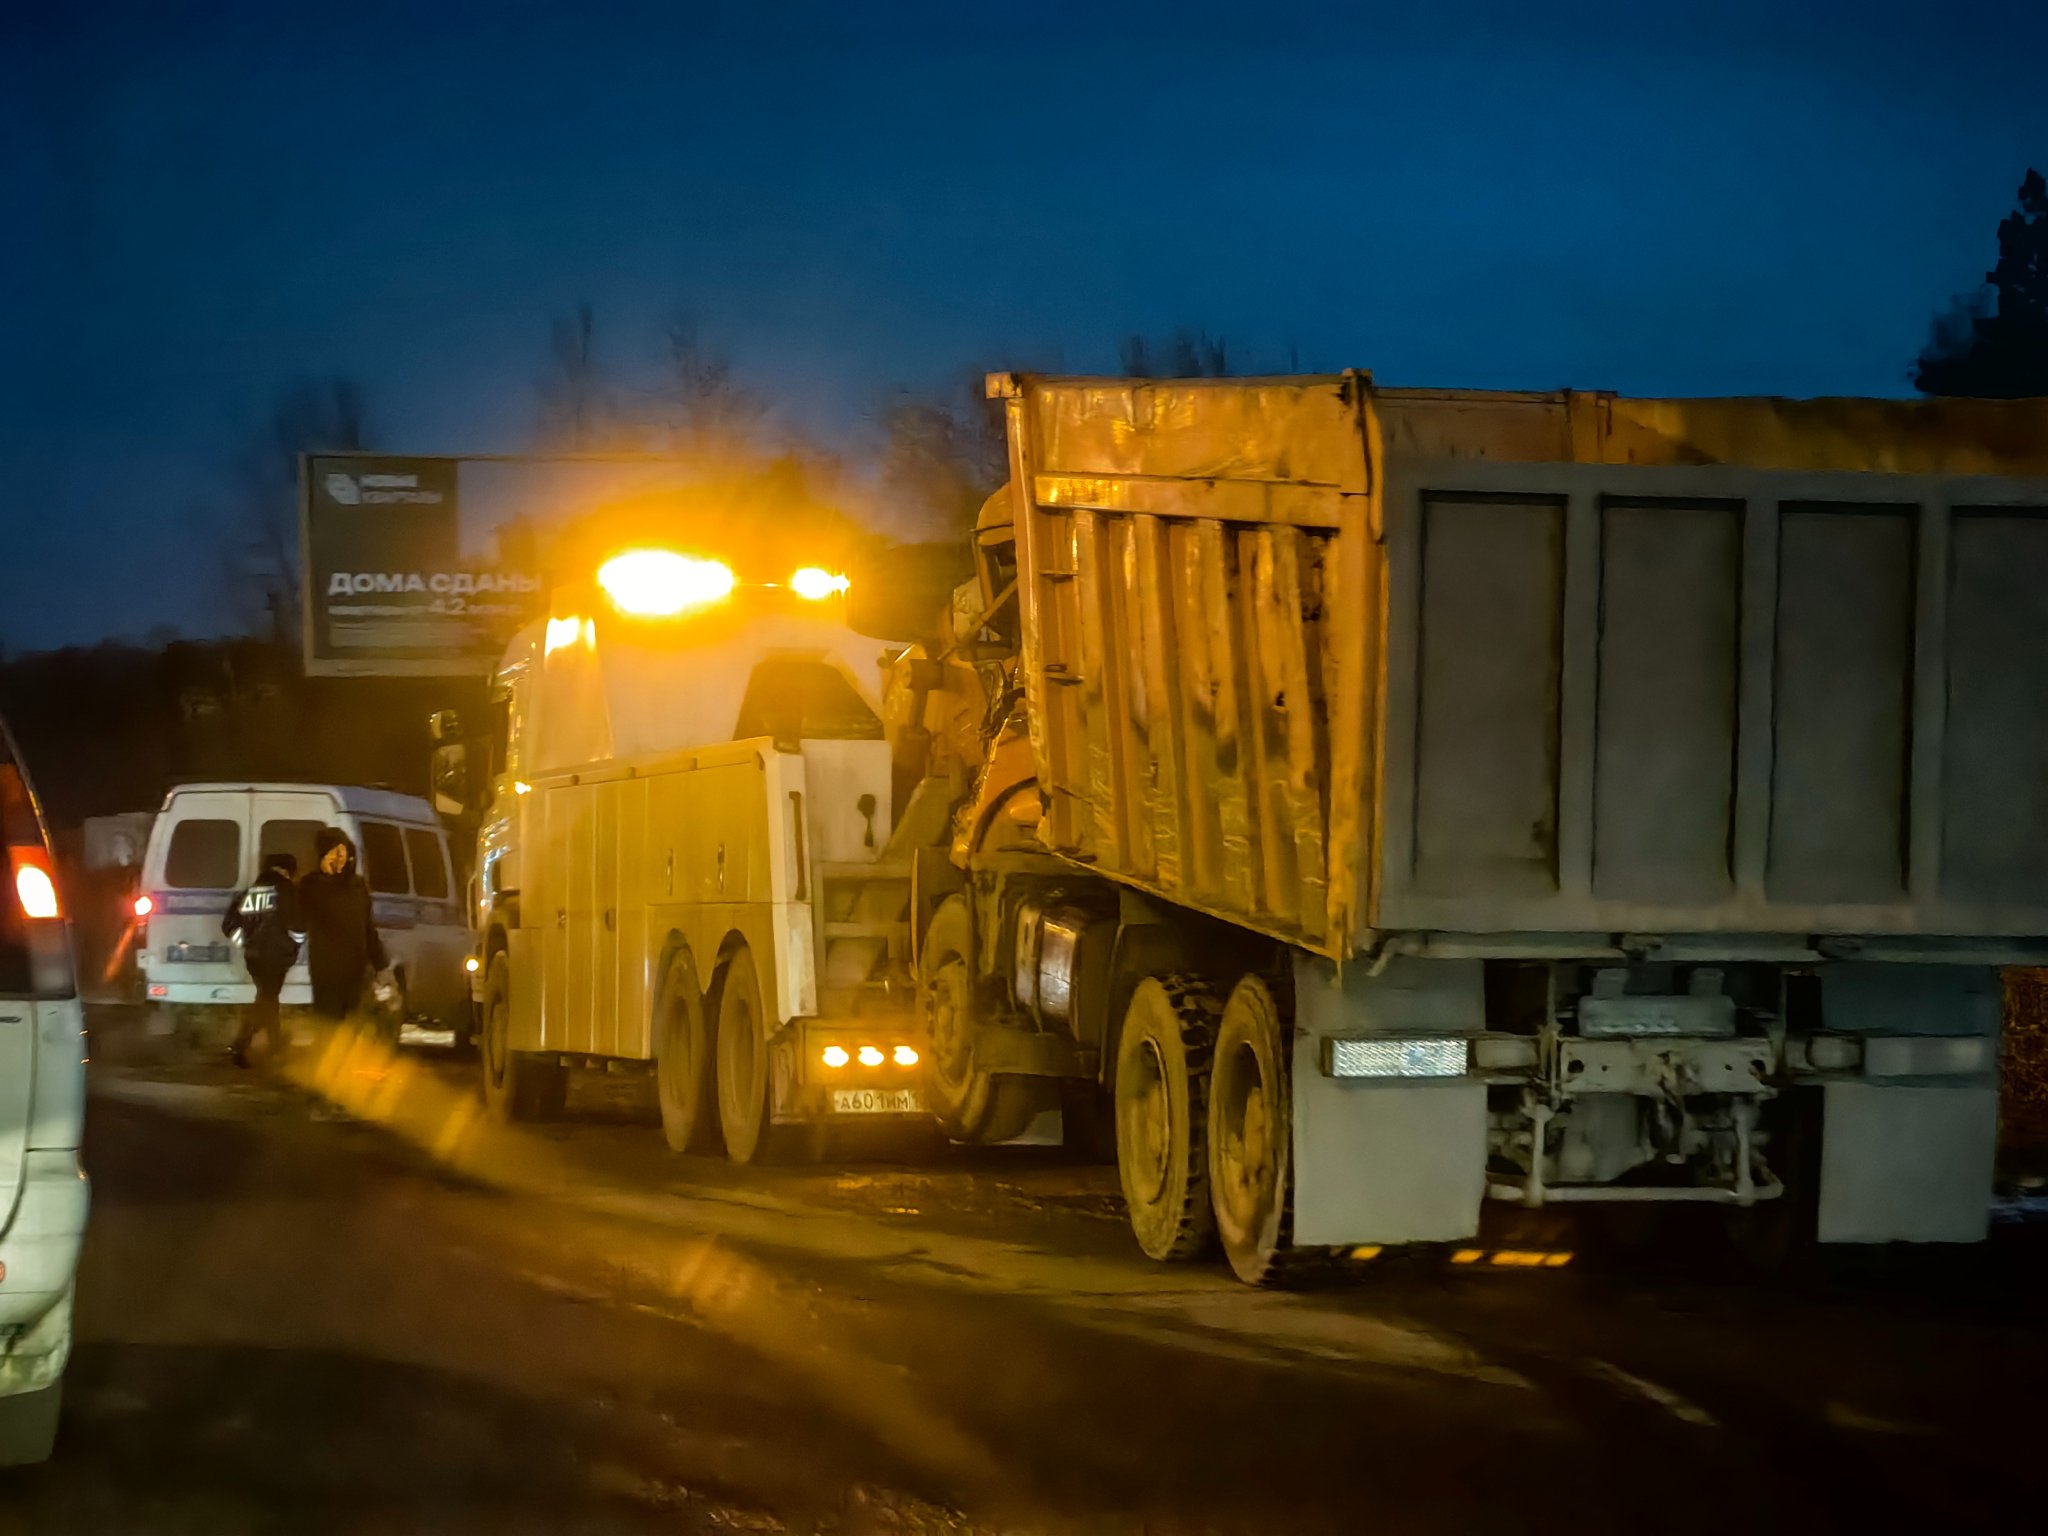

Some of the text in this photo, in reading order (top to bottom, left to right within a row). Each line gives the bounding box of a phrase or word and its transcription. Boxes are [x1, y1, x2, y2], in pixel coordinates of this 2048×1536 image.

[328, 572, 540, 596] ДОМА СДАНЫ
[241, 893, 275, 912] ДПС
